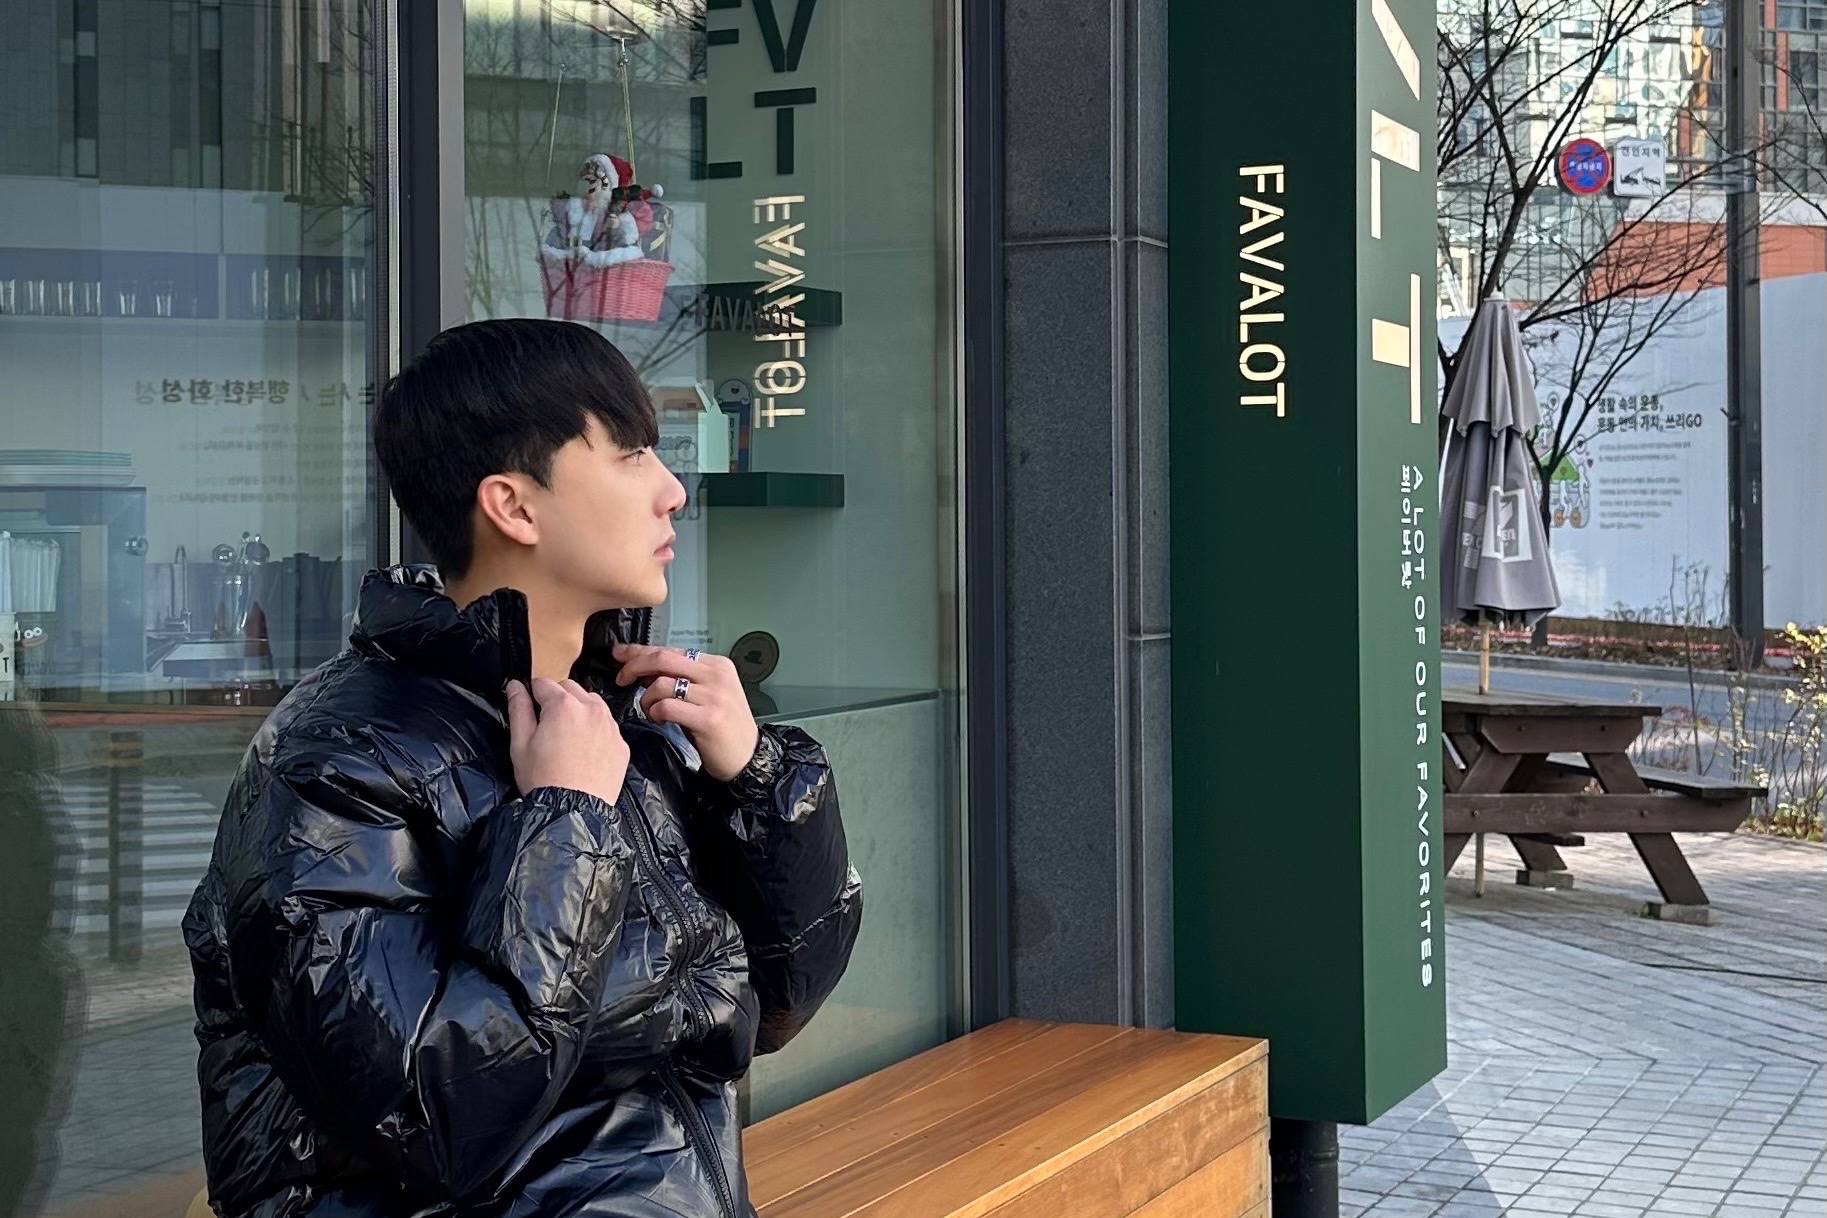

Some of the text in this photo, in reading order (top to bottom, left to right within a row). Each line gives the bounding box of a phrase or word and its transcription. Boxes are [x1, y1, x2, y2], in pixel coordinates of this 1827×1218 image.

[1240, 165, 1285, 417] FAVALOT
[1665, 413, 1703, 429] 쓰리GO
[1413, 465, 1433, 987] A LOT OF OUR FAVORITES
